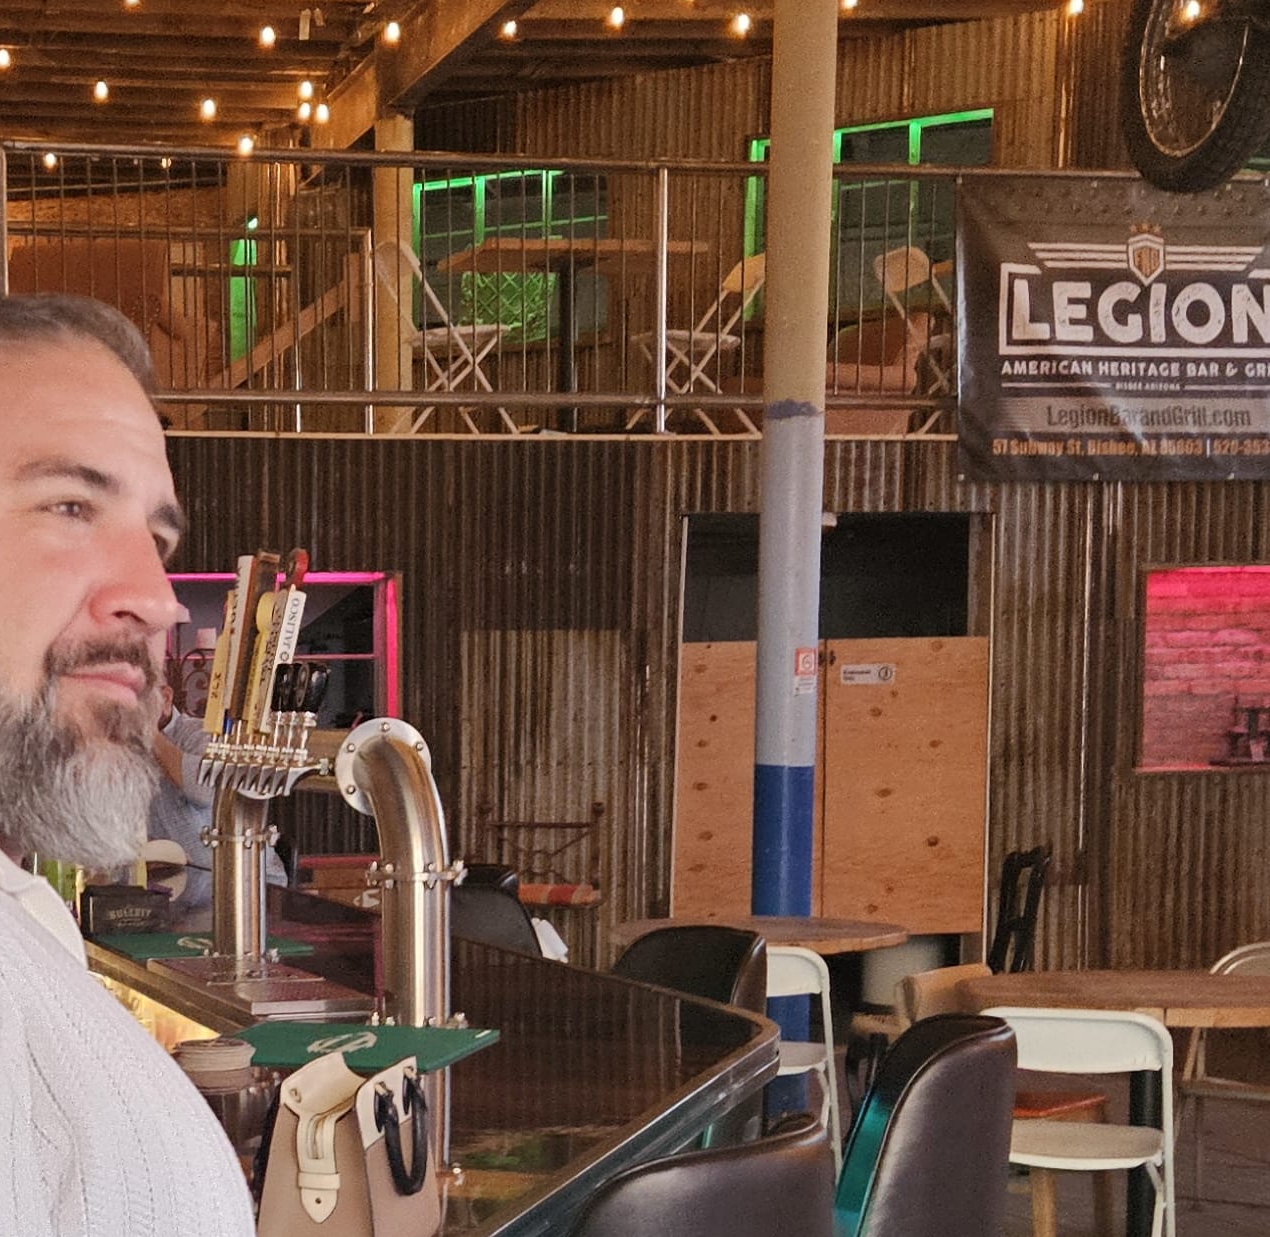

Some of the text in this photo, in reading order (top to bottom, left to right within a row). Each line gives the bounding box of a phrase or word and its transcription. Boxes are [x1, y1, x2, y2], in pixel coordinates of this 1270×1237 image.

[1012, 279, 1270, 344] LEGION
[1001, 360, 1093, 376] AMERICAN
[1099, 361, 1180, 377] HERITAGE
[1186, 361, 1219, 377] BAR
[1225, 362, 1238, 377] &
[1046, 404, 1251, 429] LegionBarandGrill.com
[283, 598, 300, 649] JALISCO
